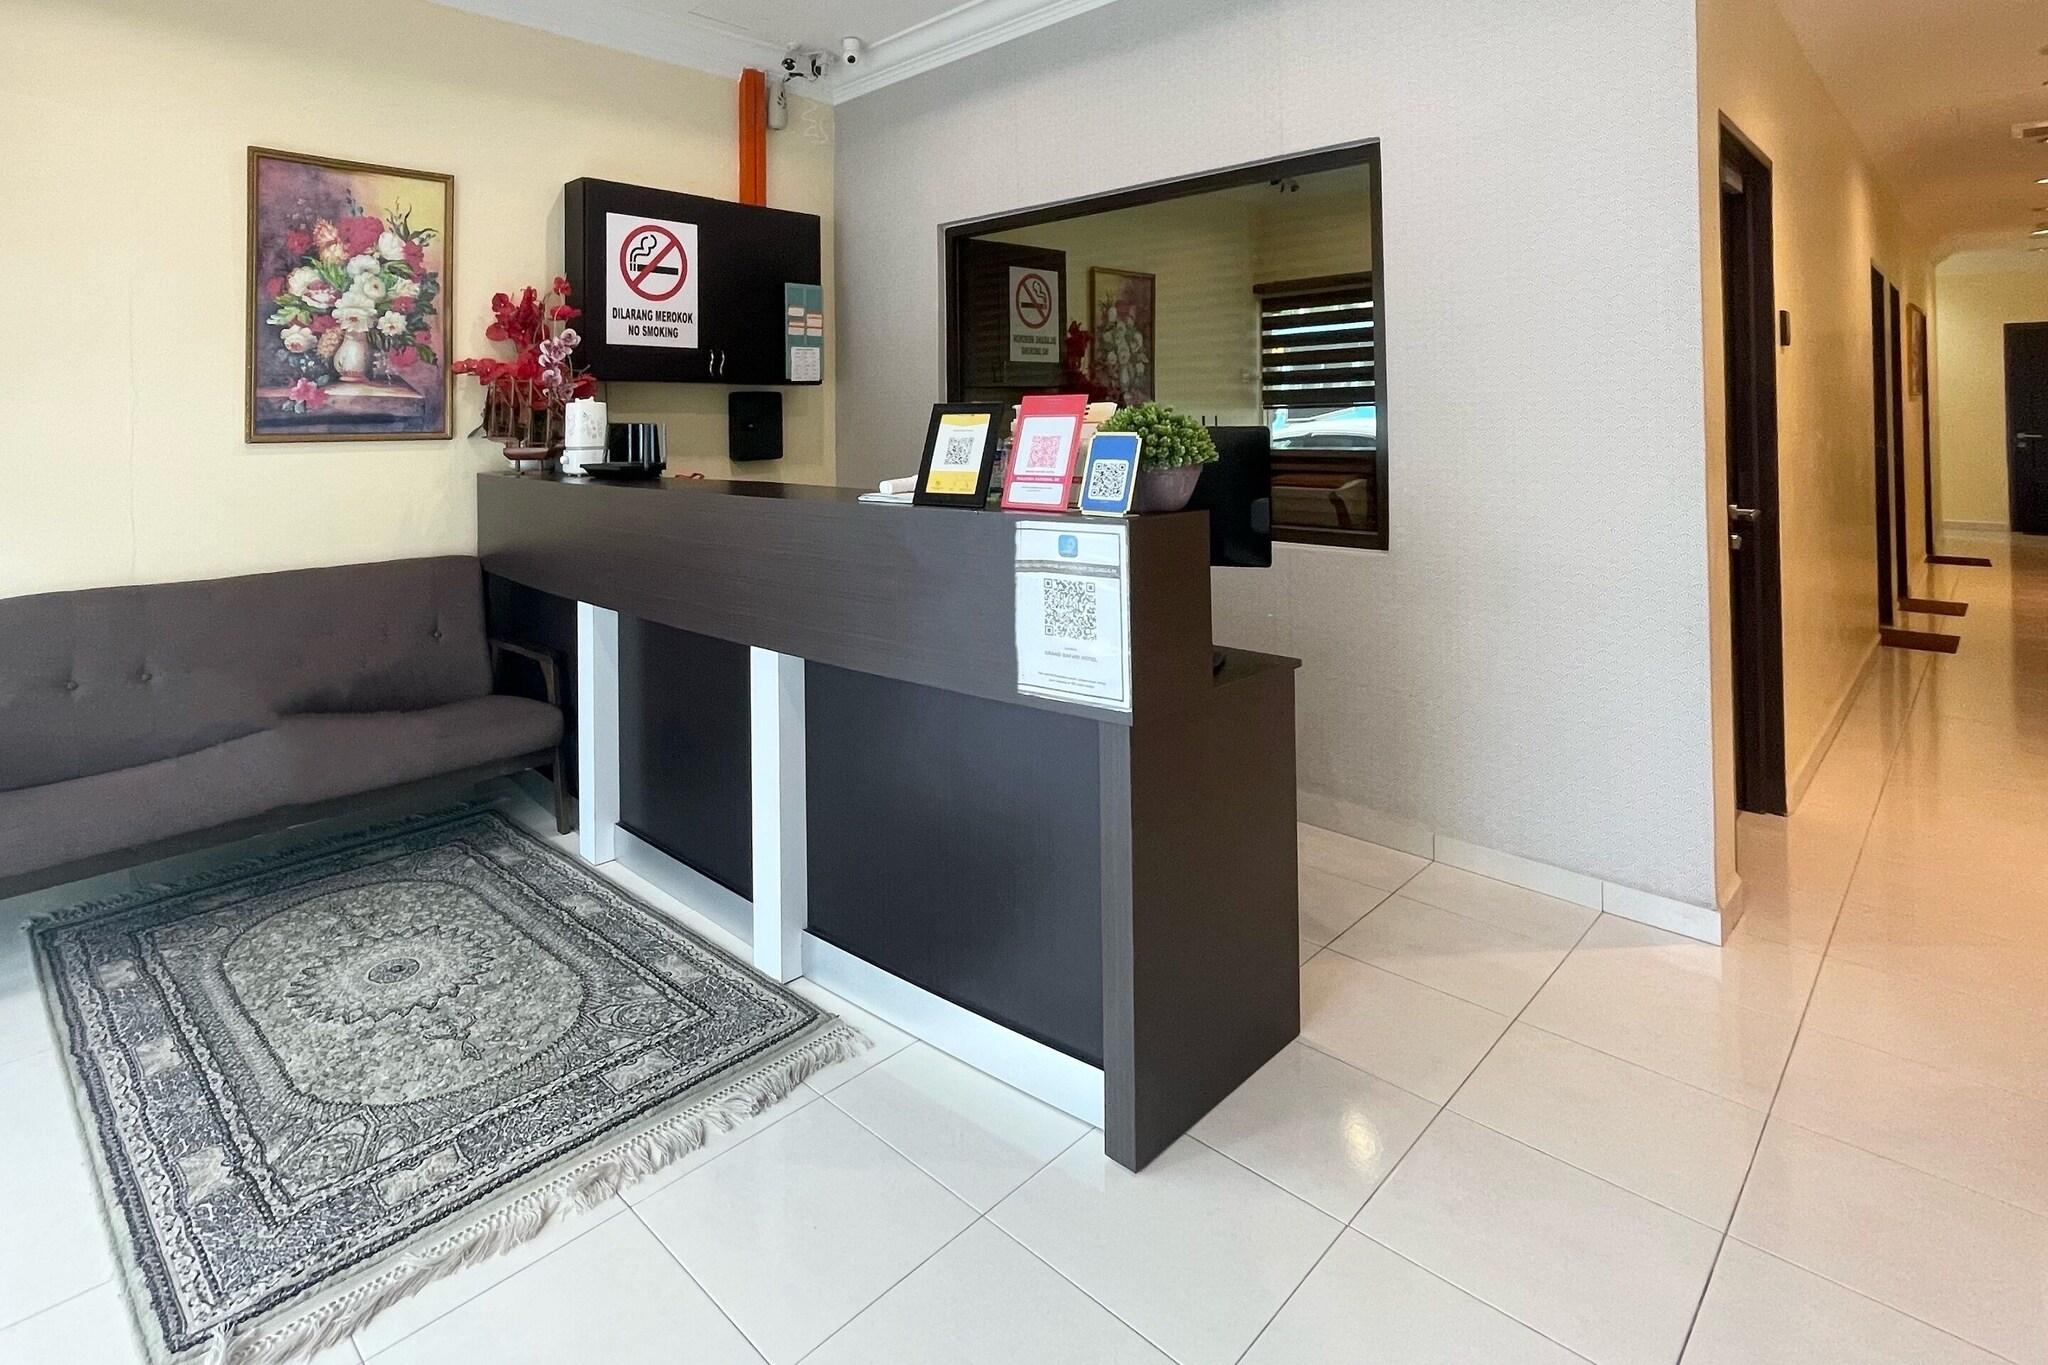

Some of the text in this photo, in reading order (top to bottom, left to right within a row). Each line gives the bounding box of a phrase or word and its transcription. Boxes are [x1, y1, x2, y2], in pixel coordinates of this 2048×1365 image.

[612, 307, 694, 324] DILARANG MEROKOK
[628, 324, 679, 338] NO SMOKING
